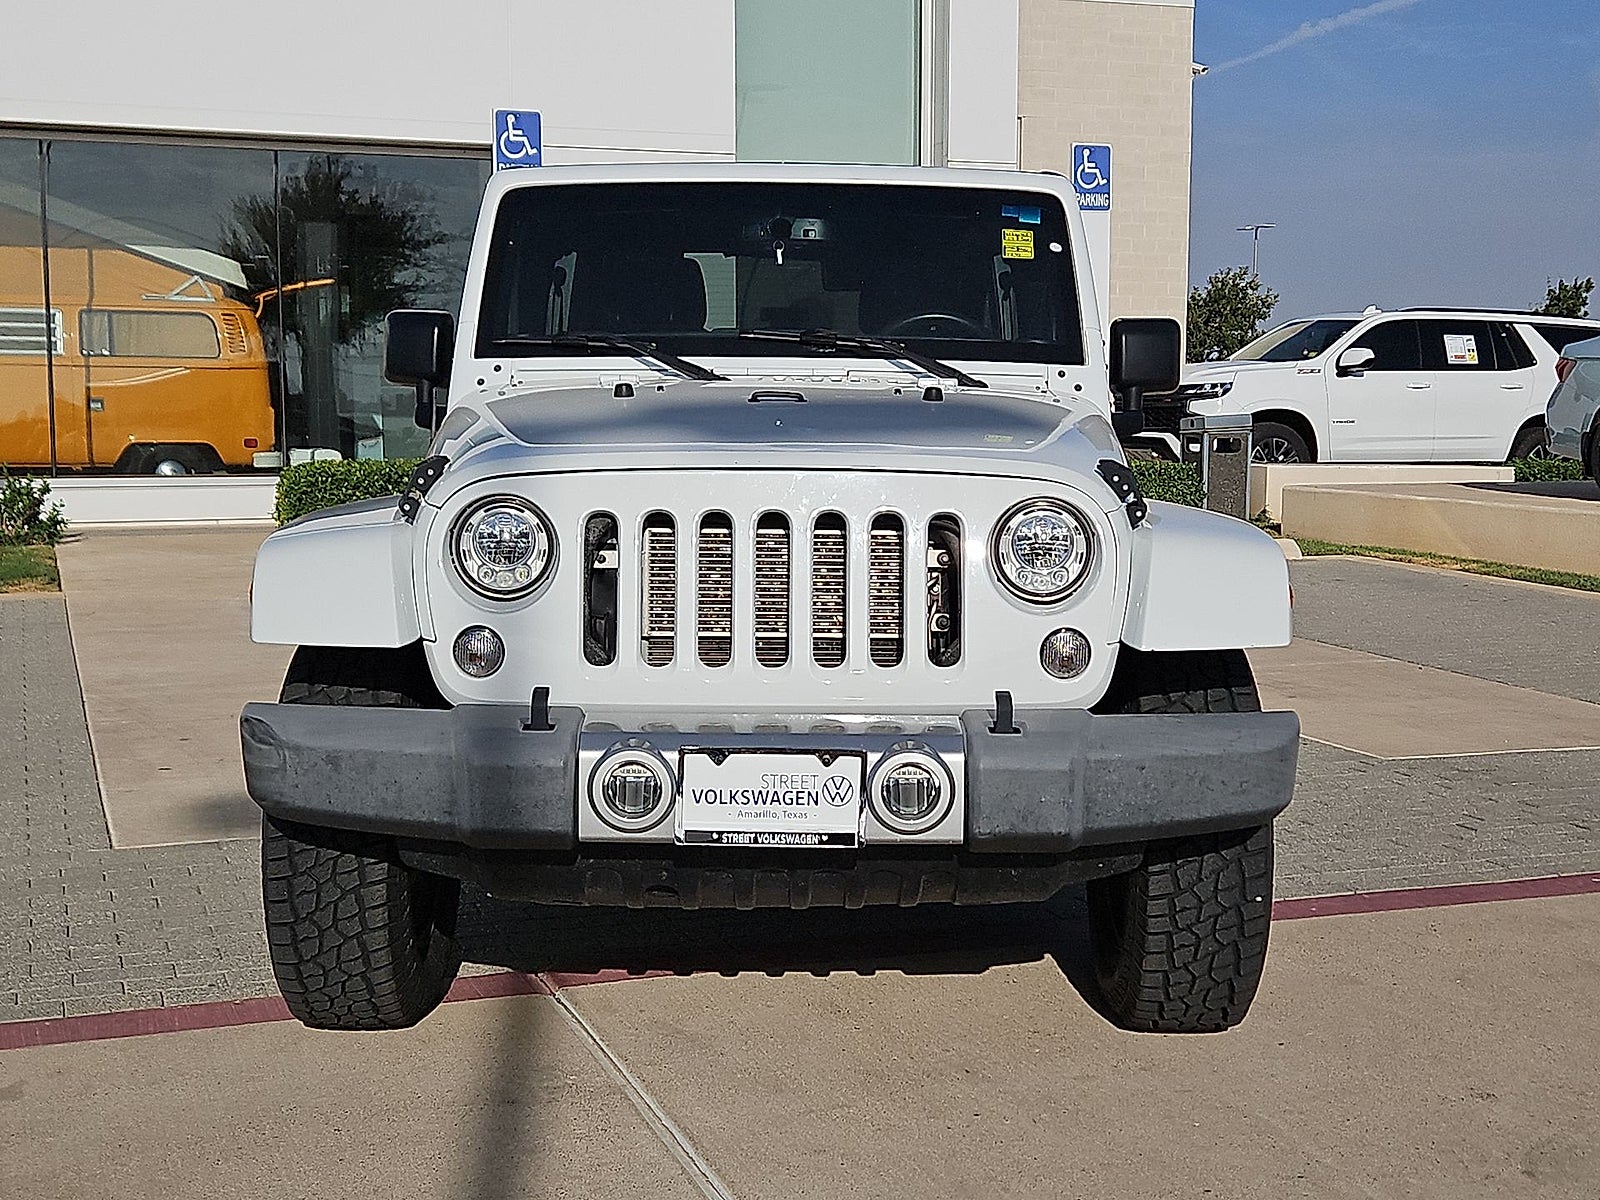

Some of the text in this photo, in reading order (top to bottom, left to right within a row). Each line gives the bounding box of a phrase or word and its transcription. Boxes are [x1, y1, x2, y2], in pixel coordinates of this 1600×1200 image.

[1076, 193, 1109, 206] PARKING
[761, 774, 819, 789] STREET
[692, 789, 819, 806] VOLKSWAGEN
[737, 810, 808, 819] Amarillo, Texas
[721, 833, 819, 845] STREET VOLKSWAGEN
